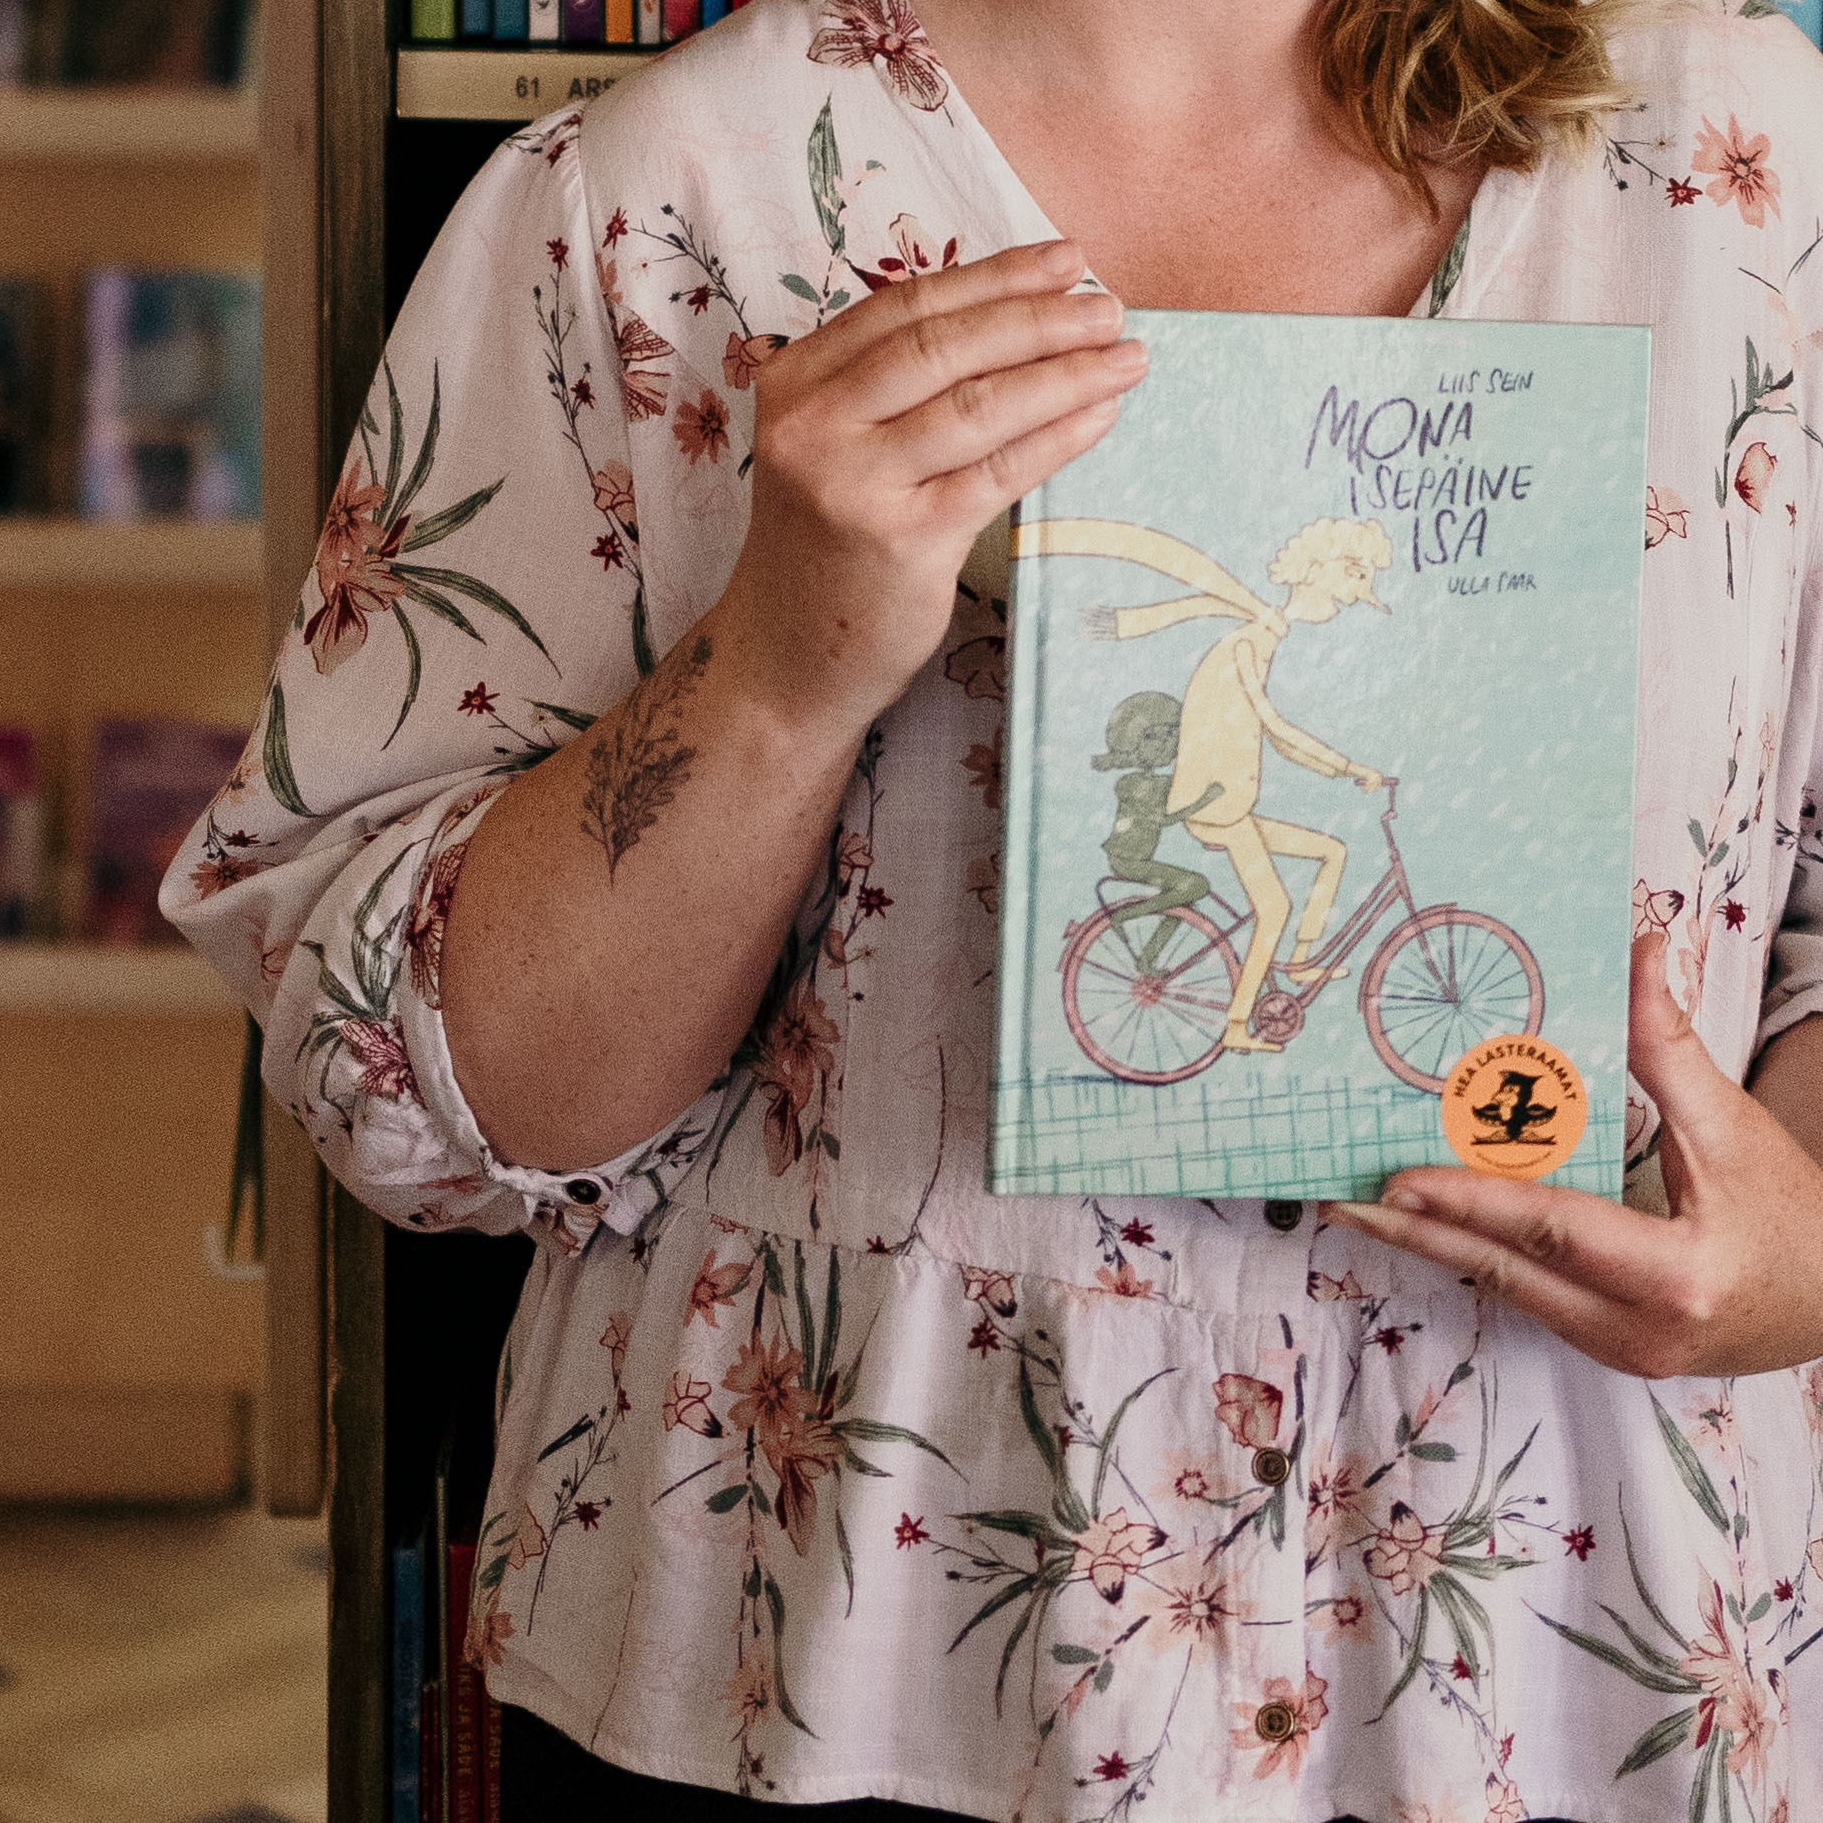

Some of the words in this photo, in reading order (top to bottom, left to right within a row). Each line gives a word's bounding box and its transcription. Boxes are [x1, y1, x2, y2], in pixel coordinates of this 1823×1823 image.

[516, 75, 539, 98] 61
[1438, 370, 1480, 394] LIIS
[1485, 368, 1534, 394] SEIN
[1305, 385, 1473, 475] MONA
[1349, 454, 1533, 516] ISEPÄINE
[1412, 507, 1487, 573] ISA
[1448, 576, 1490, 596] ULLA
[1498, 571, 1536, 594] SAAR
[1454, 1068, 1476, 1097] HEA
[1476, 1044, 1577, 1100] LASTERAAMAT
